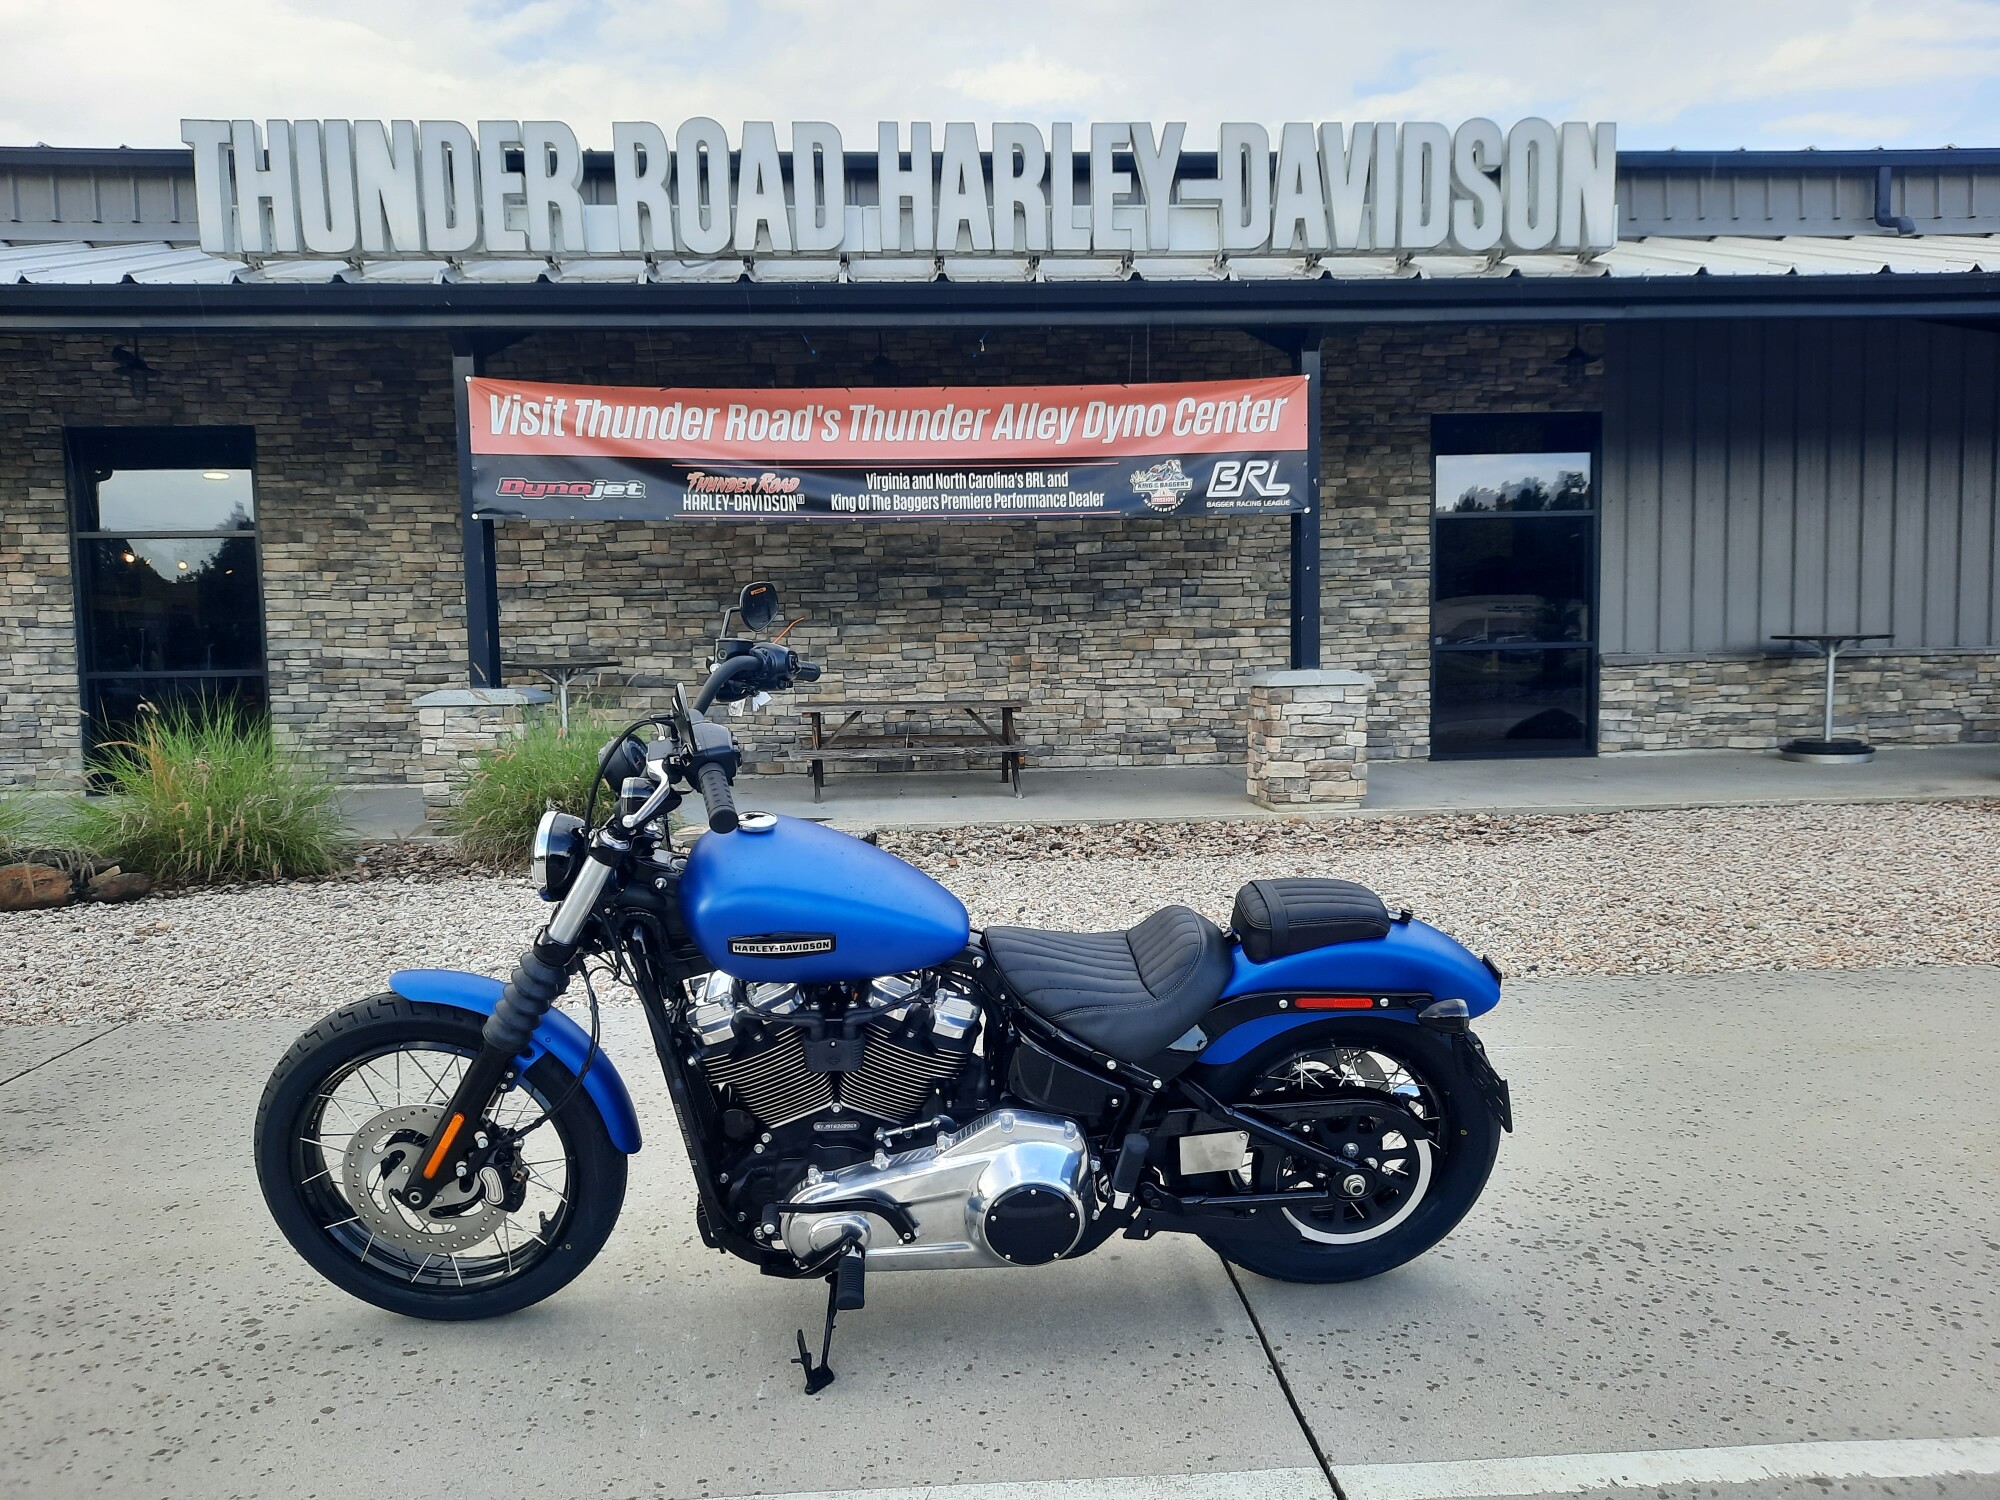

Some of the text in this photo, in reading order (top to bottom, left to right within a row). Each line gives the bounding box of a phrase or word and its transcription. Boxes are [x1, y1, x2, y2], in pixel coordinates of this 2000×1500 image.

[180, 117, 1617, 257] THUNDER ROAD HARLEY-DAVIDSON
[489, 393, 1288, 445] Visit Thunder Road's Thunder Alley Dyno Center
[499, 479, 643, 499] Dynojet
[687, 471, 757, 494] THUNDER
[865, 471, 1069, 491] Virginia and North Carolina's BRL and
[1206, 460, 1291, 498] BRL
[831, 491, 1105, 512] King Of The Baggers Premiere Performance Dealer
[734, 941, 830, 953] HARLEY-DAVIDSON
